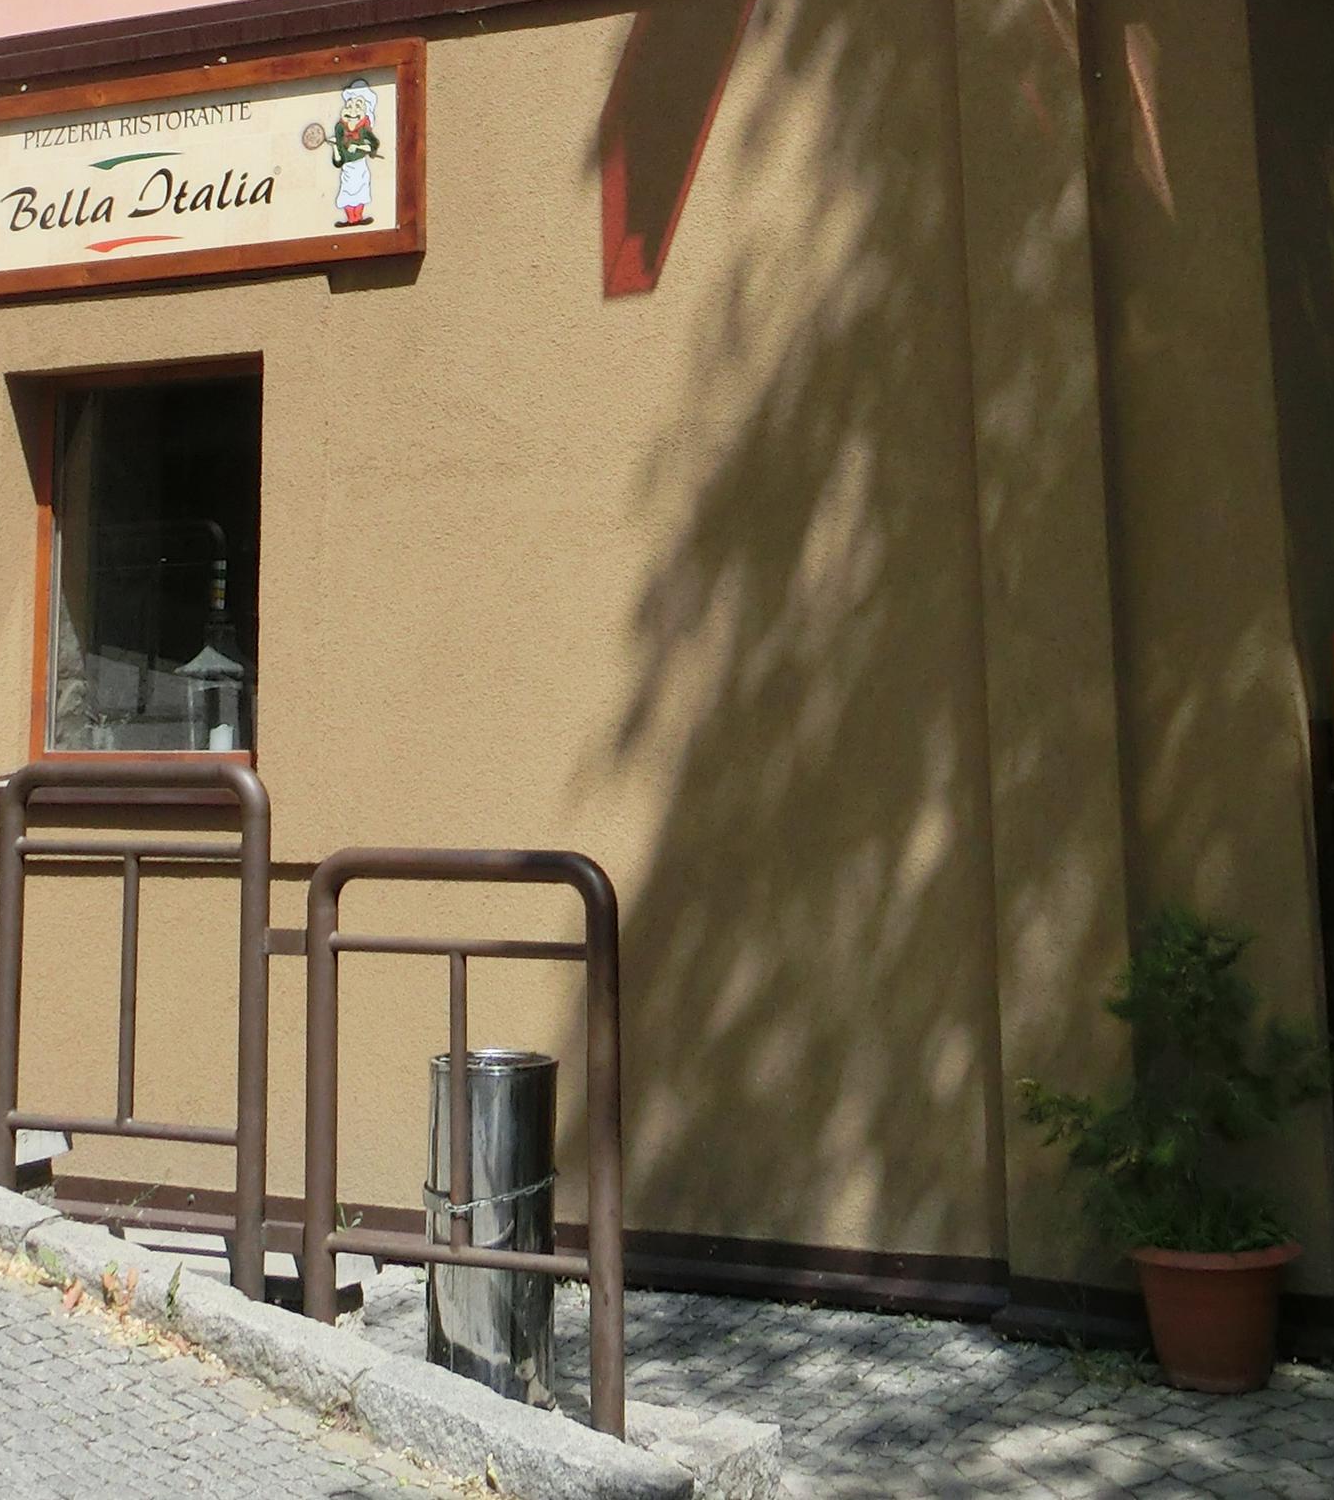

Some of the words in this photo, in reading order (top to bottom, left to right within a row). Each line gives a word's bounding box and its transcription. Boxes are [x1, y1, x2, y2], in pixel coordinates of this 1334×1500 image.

[23, 121, 111, 149] PIZZERIA
[120, 100, 252, 138] RISTORANTE
[1, 186, 114, 232] Bella
[127, 167, 275, 219] Italia
